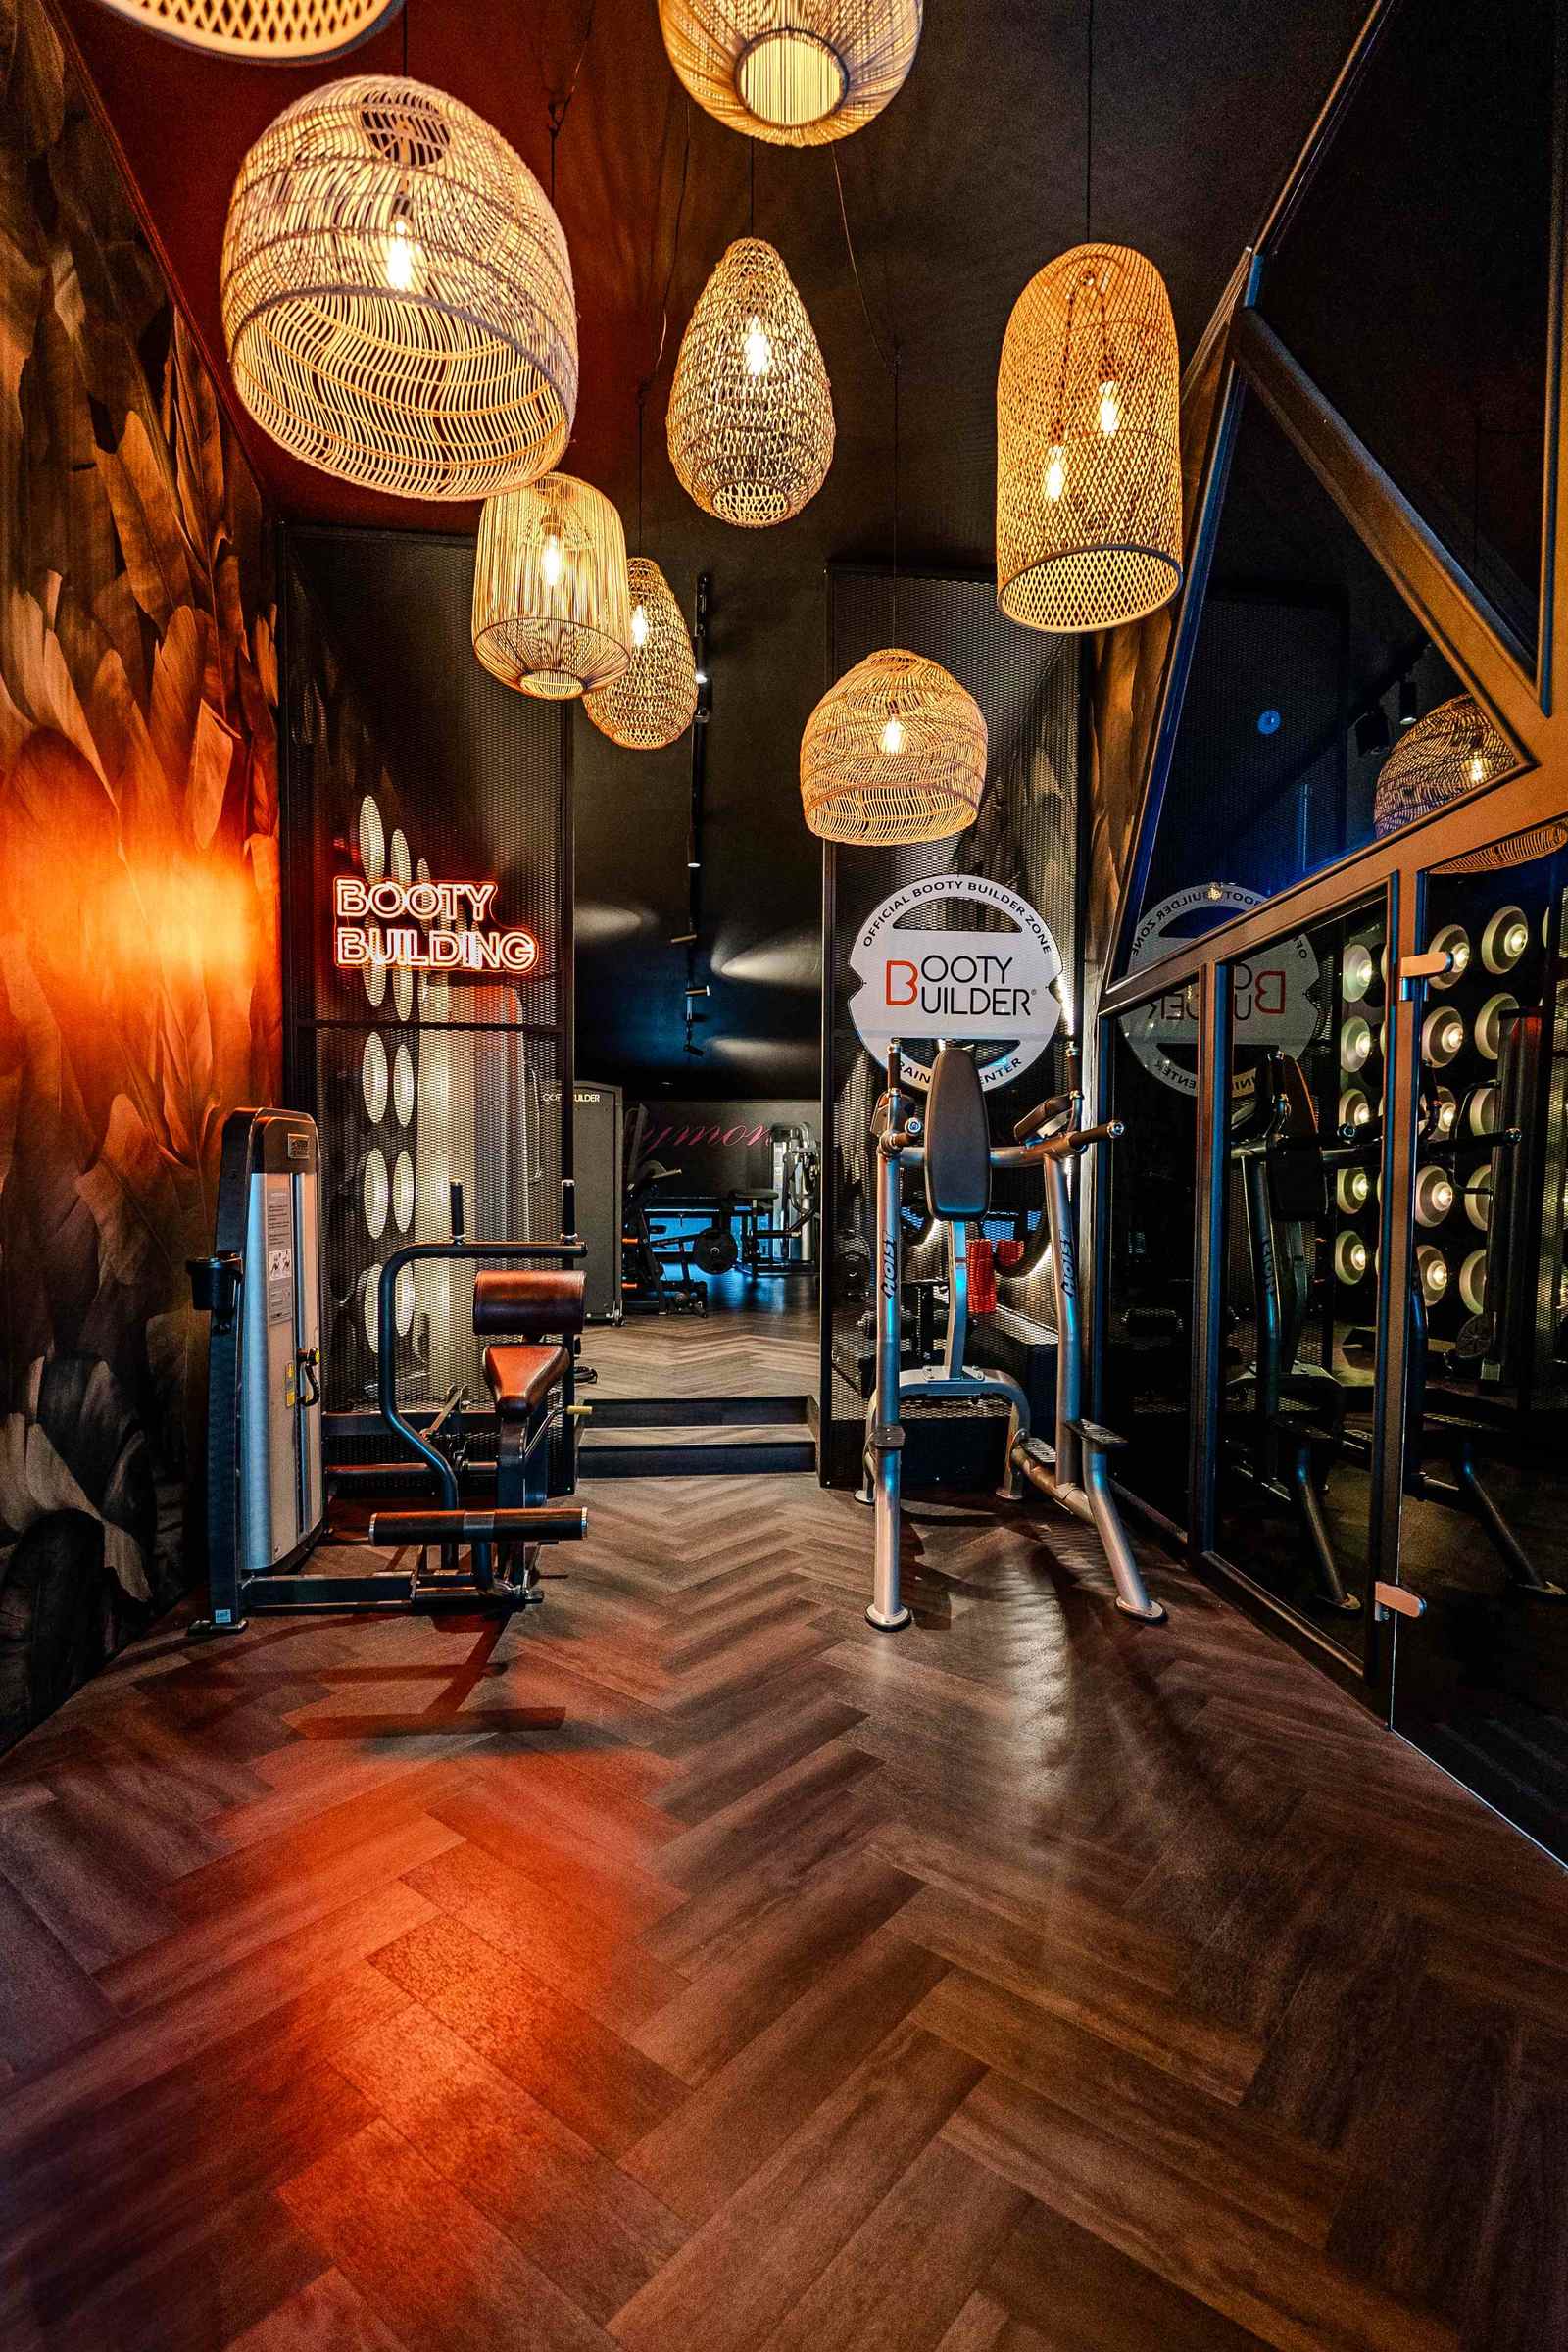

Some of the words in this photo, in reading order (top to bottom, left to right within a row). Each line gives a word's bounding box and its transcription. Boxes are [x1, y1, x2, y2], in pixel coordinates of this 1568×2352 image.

[336, 878, 495, 921] BOOTY
[863, 895, 910, 948] OFFICIAL
[912, 881, 963, 898] BOOTY
[967, 883, 1025, 917] BUILDER
[1025, 915, 1052, 955] ZONE
[337, 926, 536, 970] BUILDING
[882, 1230, 897, 1297] HOIST
[1059, 1230, 1076, 1297] HOIST
